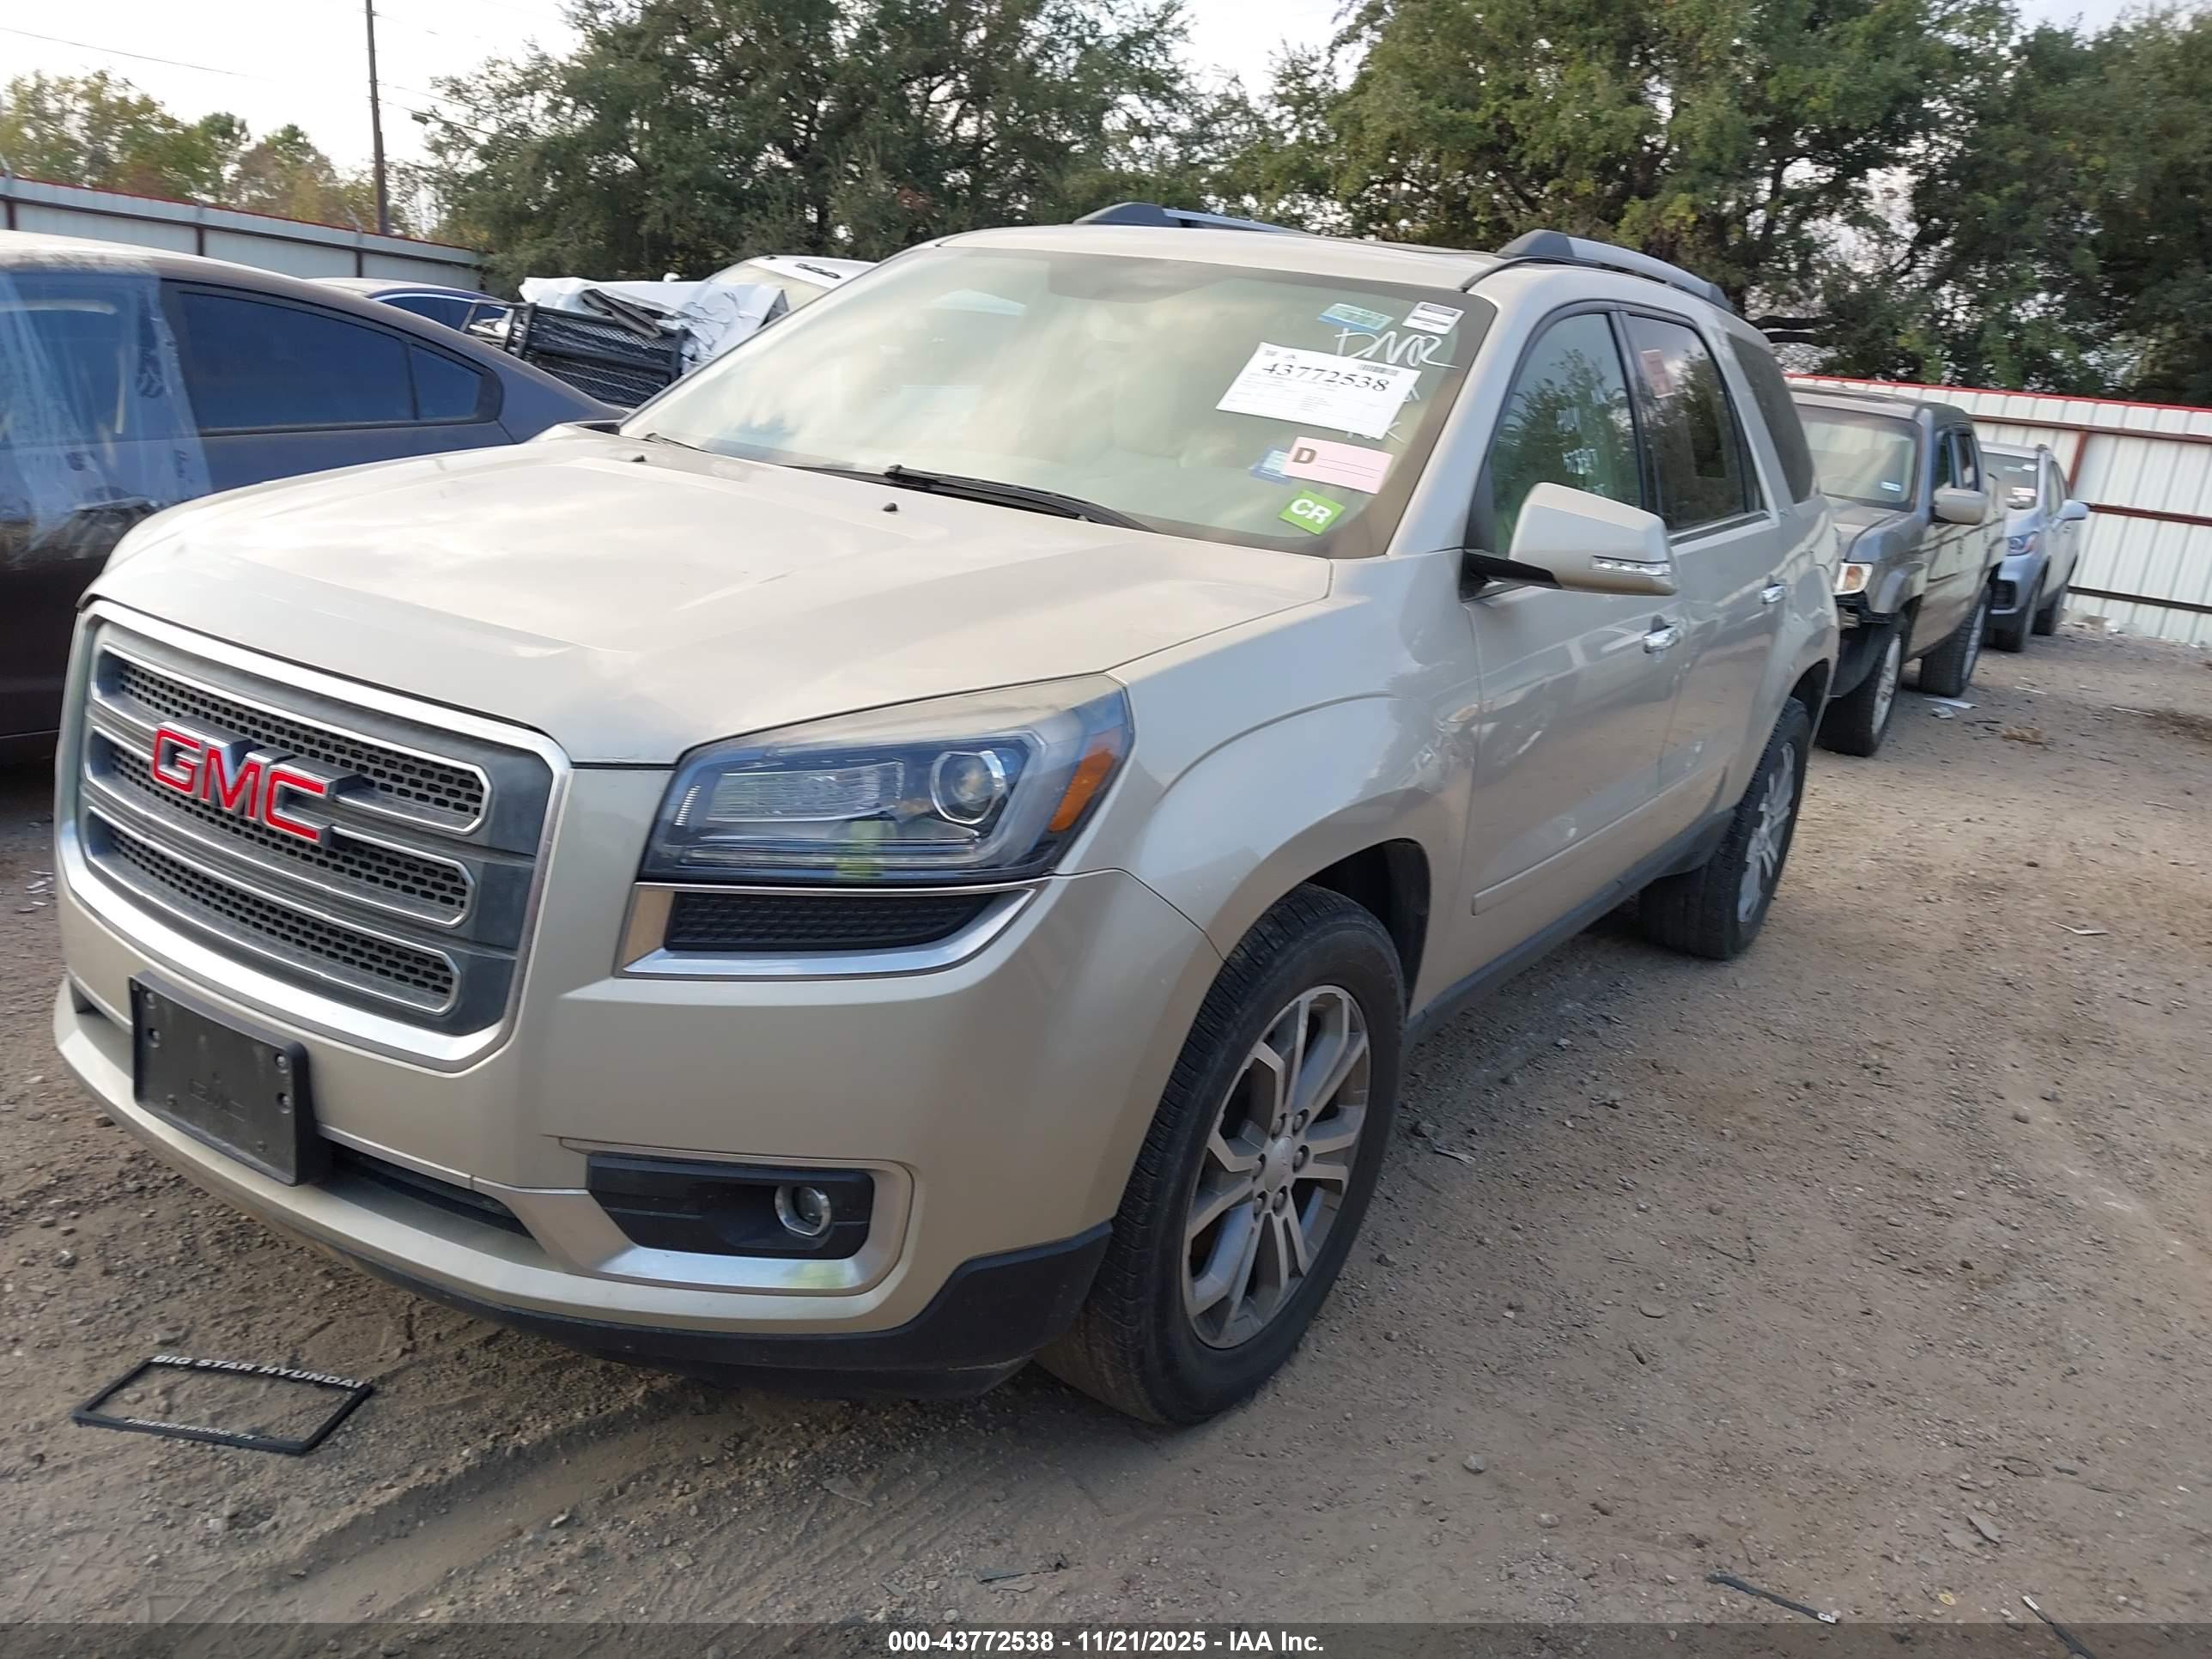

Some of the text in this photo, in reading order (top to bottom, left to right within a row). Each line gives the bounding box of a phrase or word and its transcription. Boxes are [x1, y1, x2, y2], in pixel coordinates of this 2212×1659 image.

[1262, 362, 1390, 392] 43772538
[1291, 447, 1316, 465] D
[1291, 498, 1333, 525] CR
[152, 723, 326, 844] GMC
[151, 1355, 364, 1389] BIG STAR HYUNDAI
